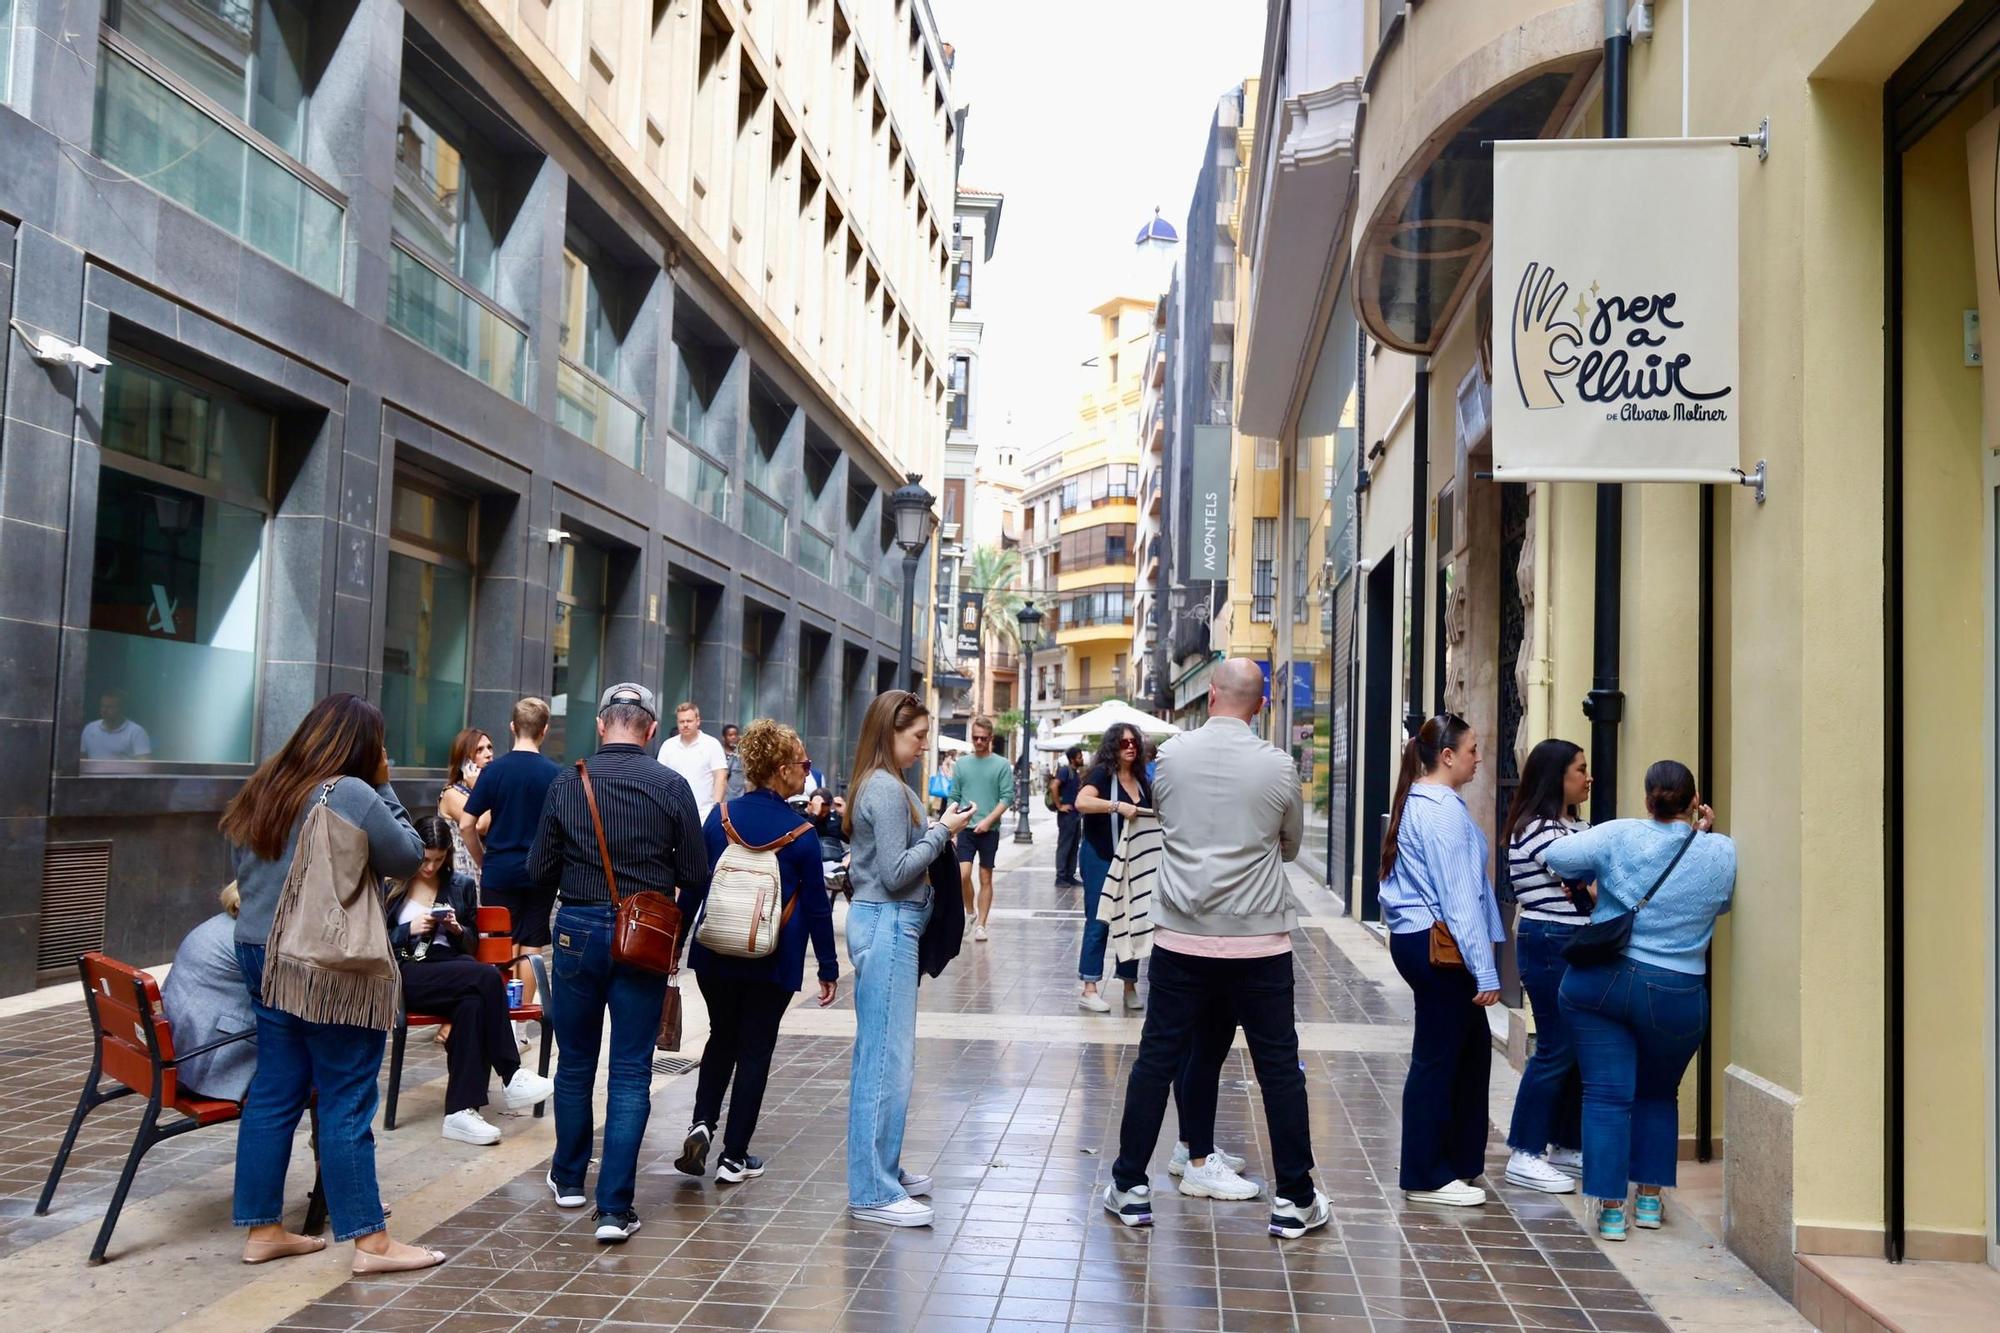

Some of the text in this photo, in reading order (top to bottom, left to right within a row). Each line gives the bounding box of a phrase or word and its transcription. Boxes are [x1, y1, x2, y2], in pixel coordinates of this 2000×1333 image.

[1589, 292, 1685, 346] per
[1626, 328, 1667, 347] a
[1576, 350, 1732, 403] lluir
[1606, 413, 1619, 421] DE
[1673, 403, 1728, 422] Moliner
